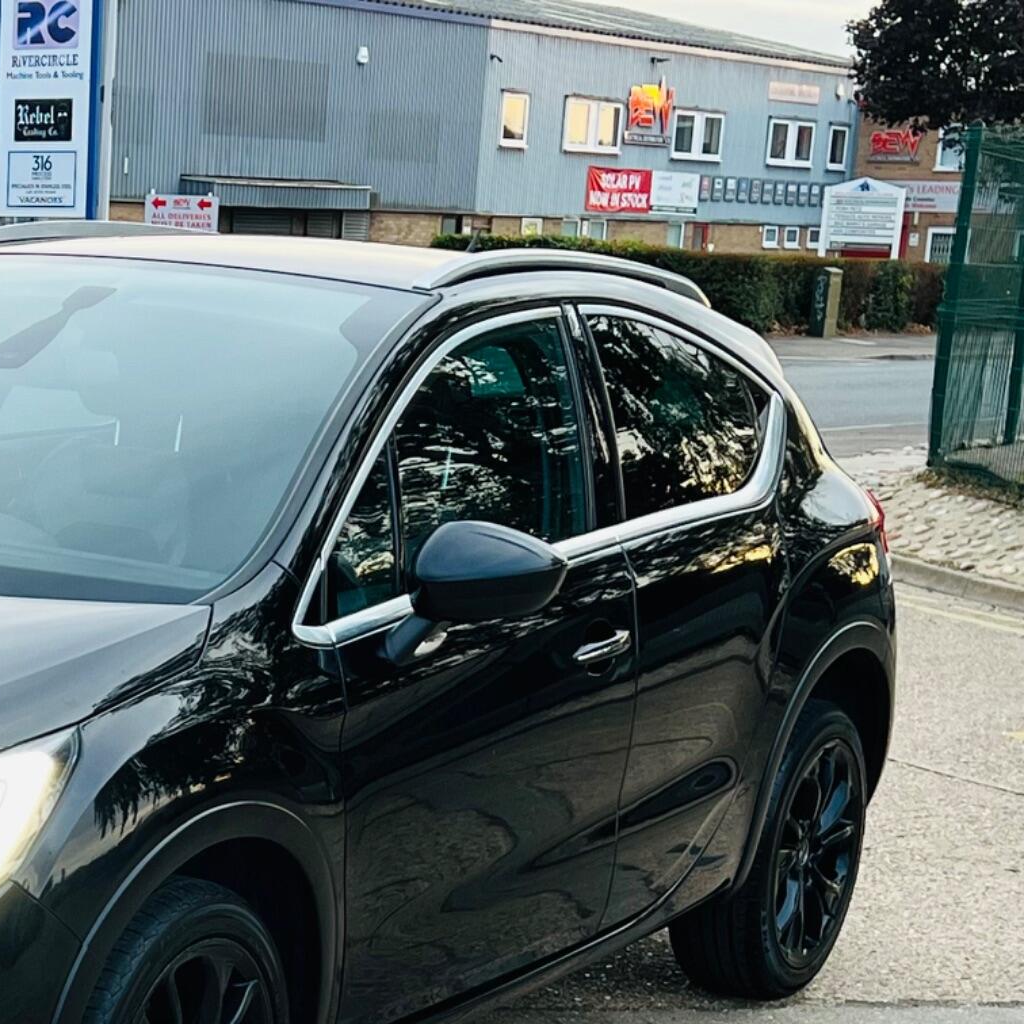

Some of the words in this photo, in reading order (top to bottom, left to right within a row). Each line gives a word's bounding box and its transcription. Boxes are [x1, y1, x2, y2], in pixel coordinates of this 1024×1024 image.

[35, 71, 51, 80] Tools
[53, 71, 59, 79] &
[17, 104, 56, 125] Rebel
[32, 155, 53, 171] 316
[629, 175, 642, 190] PV
[589, 191, 610, 207] NOW
[611, 192, 621, 207] IN
[621, 192, 649, 208] STOCK
